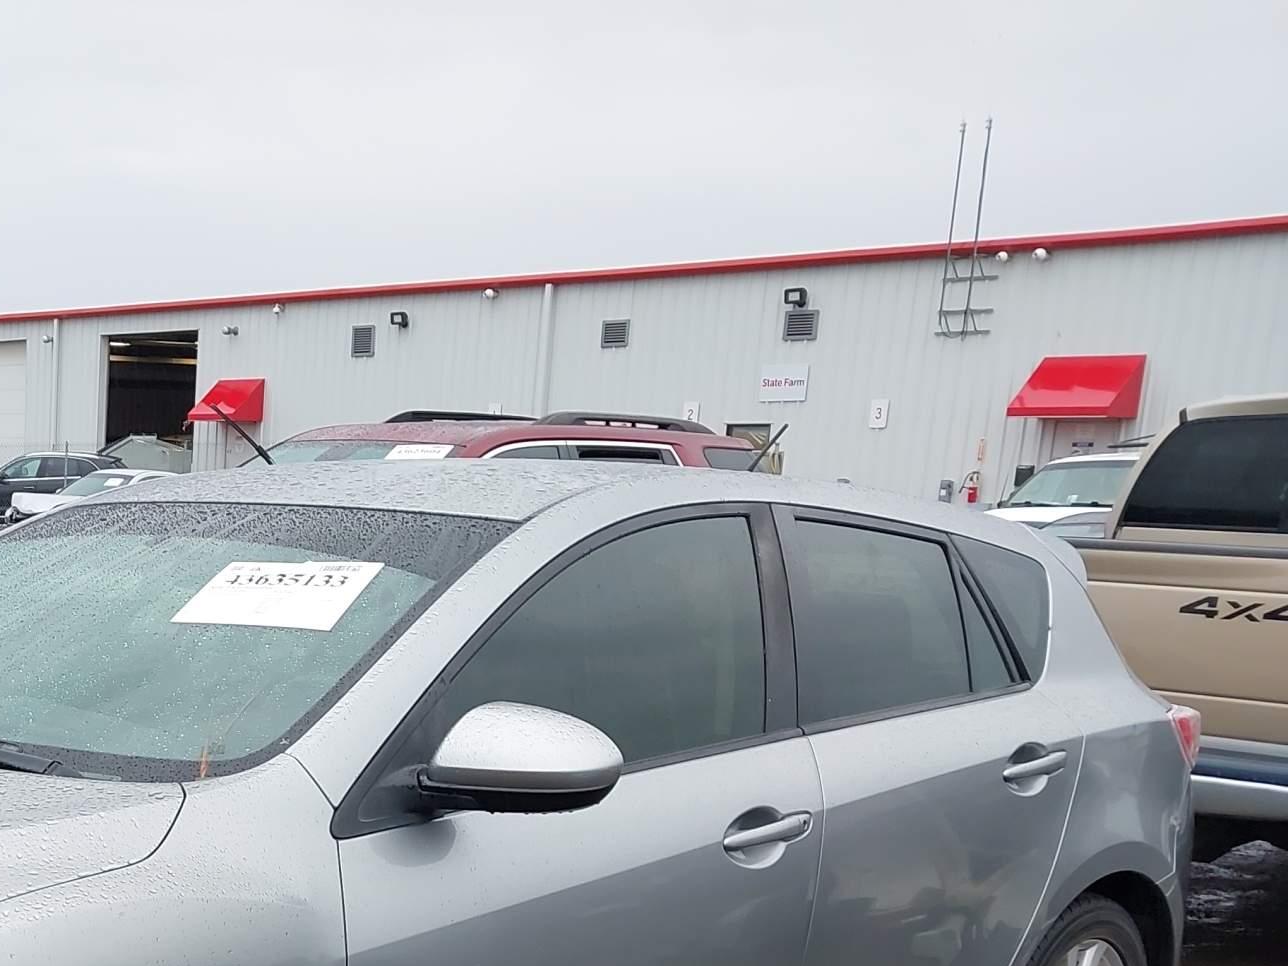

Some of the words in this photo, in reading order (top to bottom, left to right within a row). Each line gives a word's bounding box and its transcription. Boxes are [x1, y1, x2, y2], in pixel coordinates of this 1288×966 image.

[762, 378, 782, 387] State
[784, 378, 805, 387] Farm
[687, 408, 694, 420] 2
[875, 407, 882, 420] 3
[224, 573, 349, 587] 43635133
